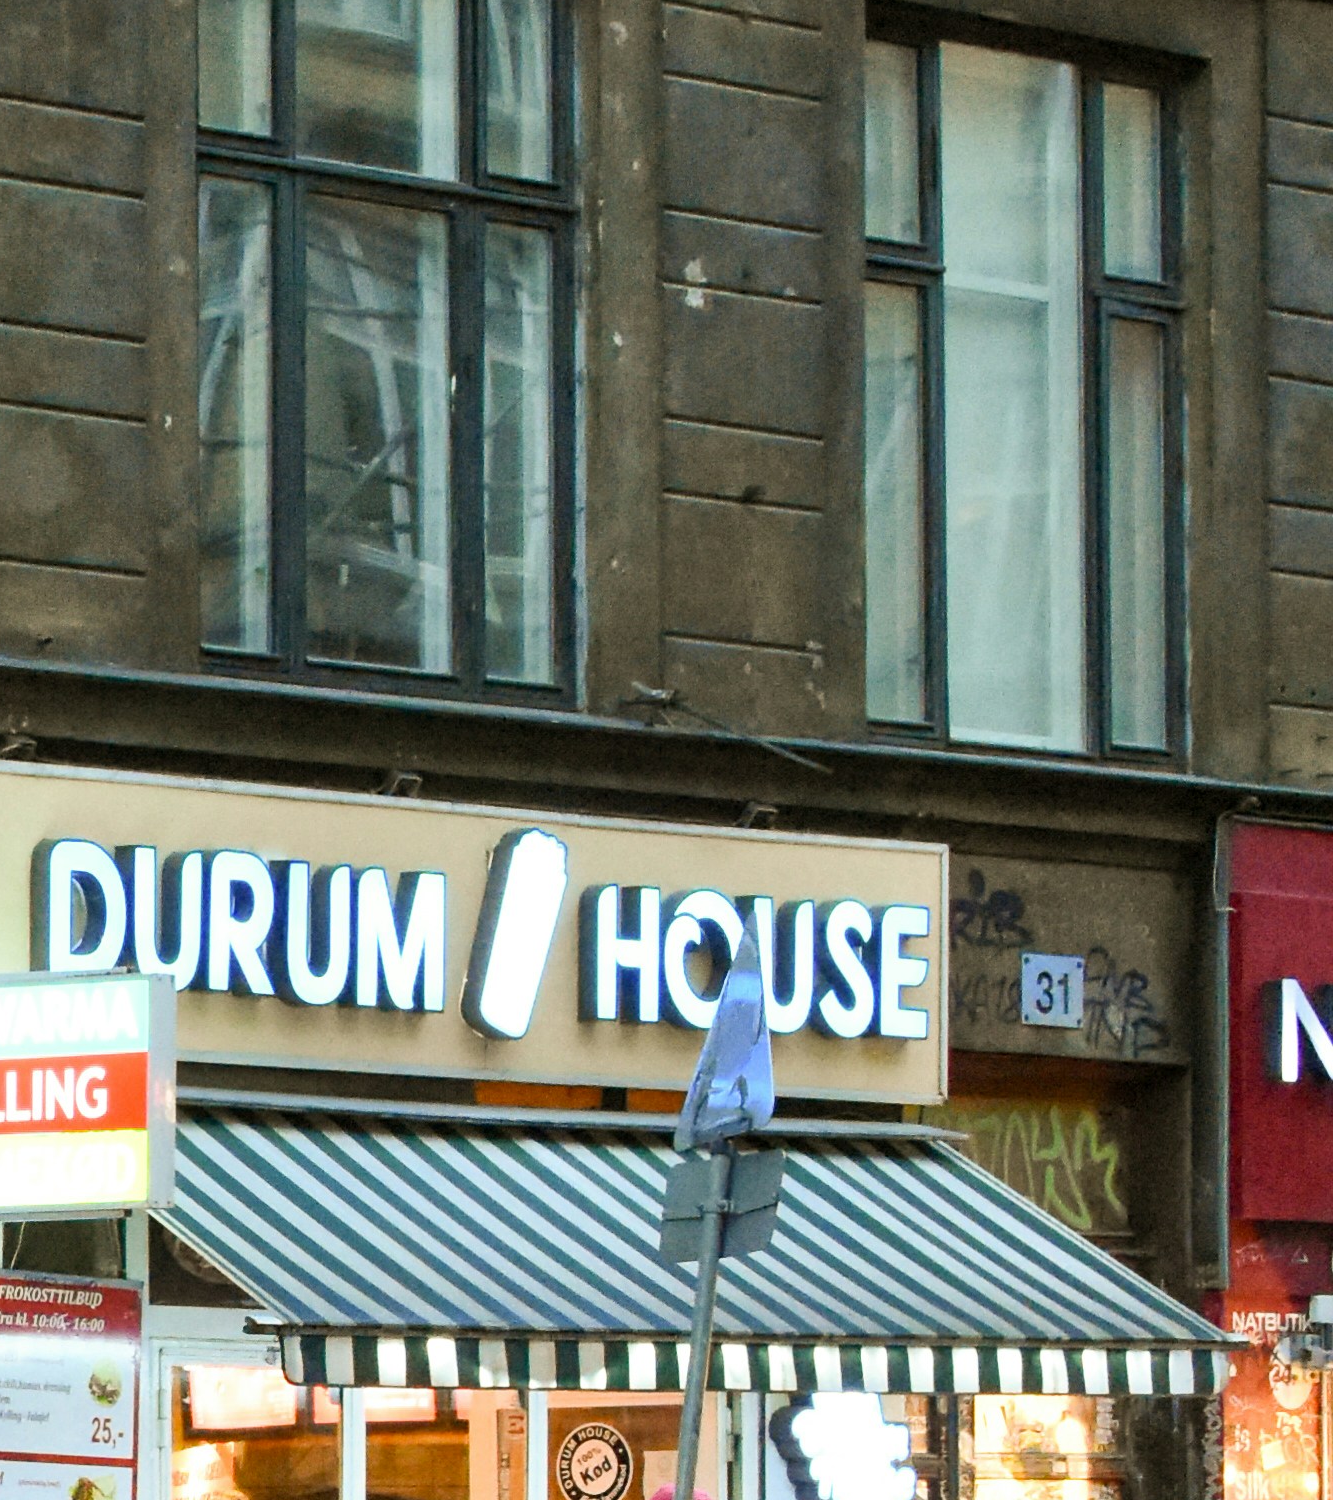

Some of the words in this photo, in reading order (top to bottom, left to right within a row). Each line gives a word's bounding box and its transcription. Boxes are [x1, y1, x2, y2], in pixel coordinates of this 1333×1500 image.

[47, 838, 446, 1013] DURUM
[595, 883, 929, 1041] HOUSE
[1035, 971, 1071, 1014] 31
[73, 1317, 105, 1332] 16:00
